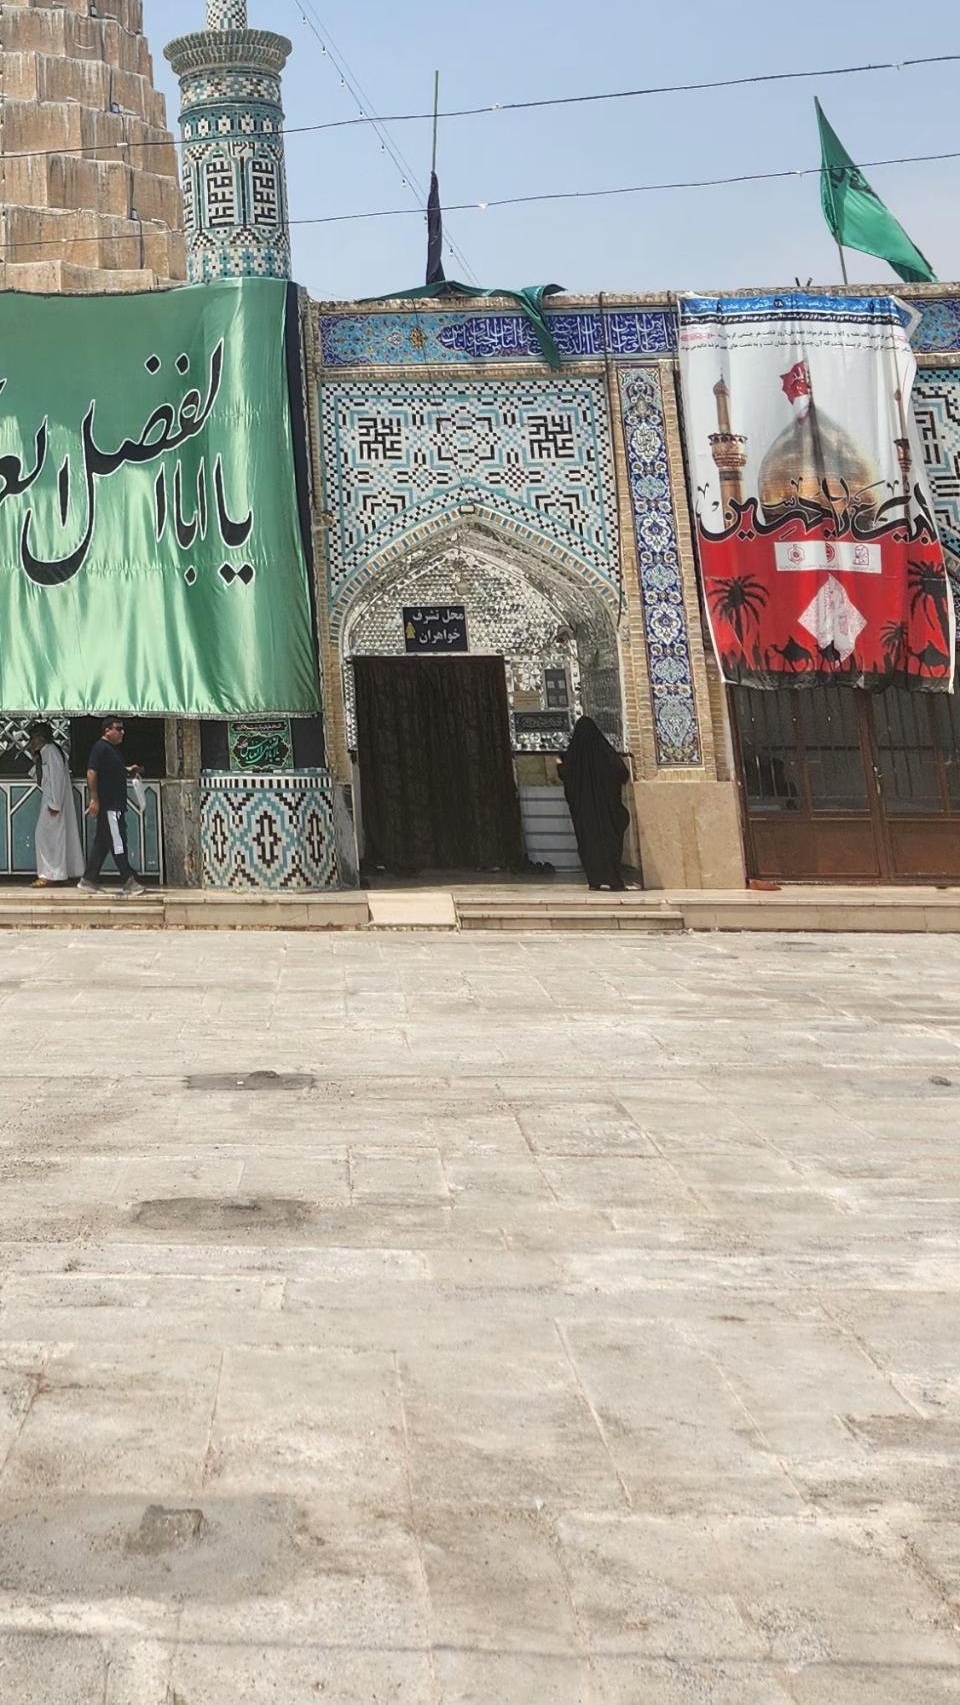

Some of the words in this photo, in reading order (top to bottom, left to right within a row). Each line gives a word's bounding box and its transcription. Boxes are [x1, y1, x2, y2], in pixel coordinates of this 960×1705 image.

[412, 609, 440, 625] تشرف
[442, 608, 465, 624] محل
[419, 627, 461, 644] خواهران
